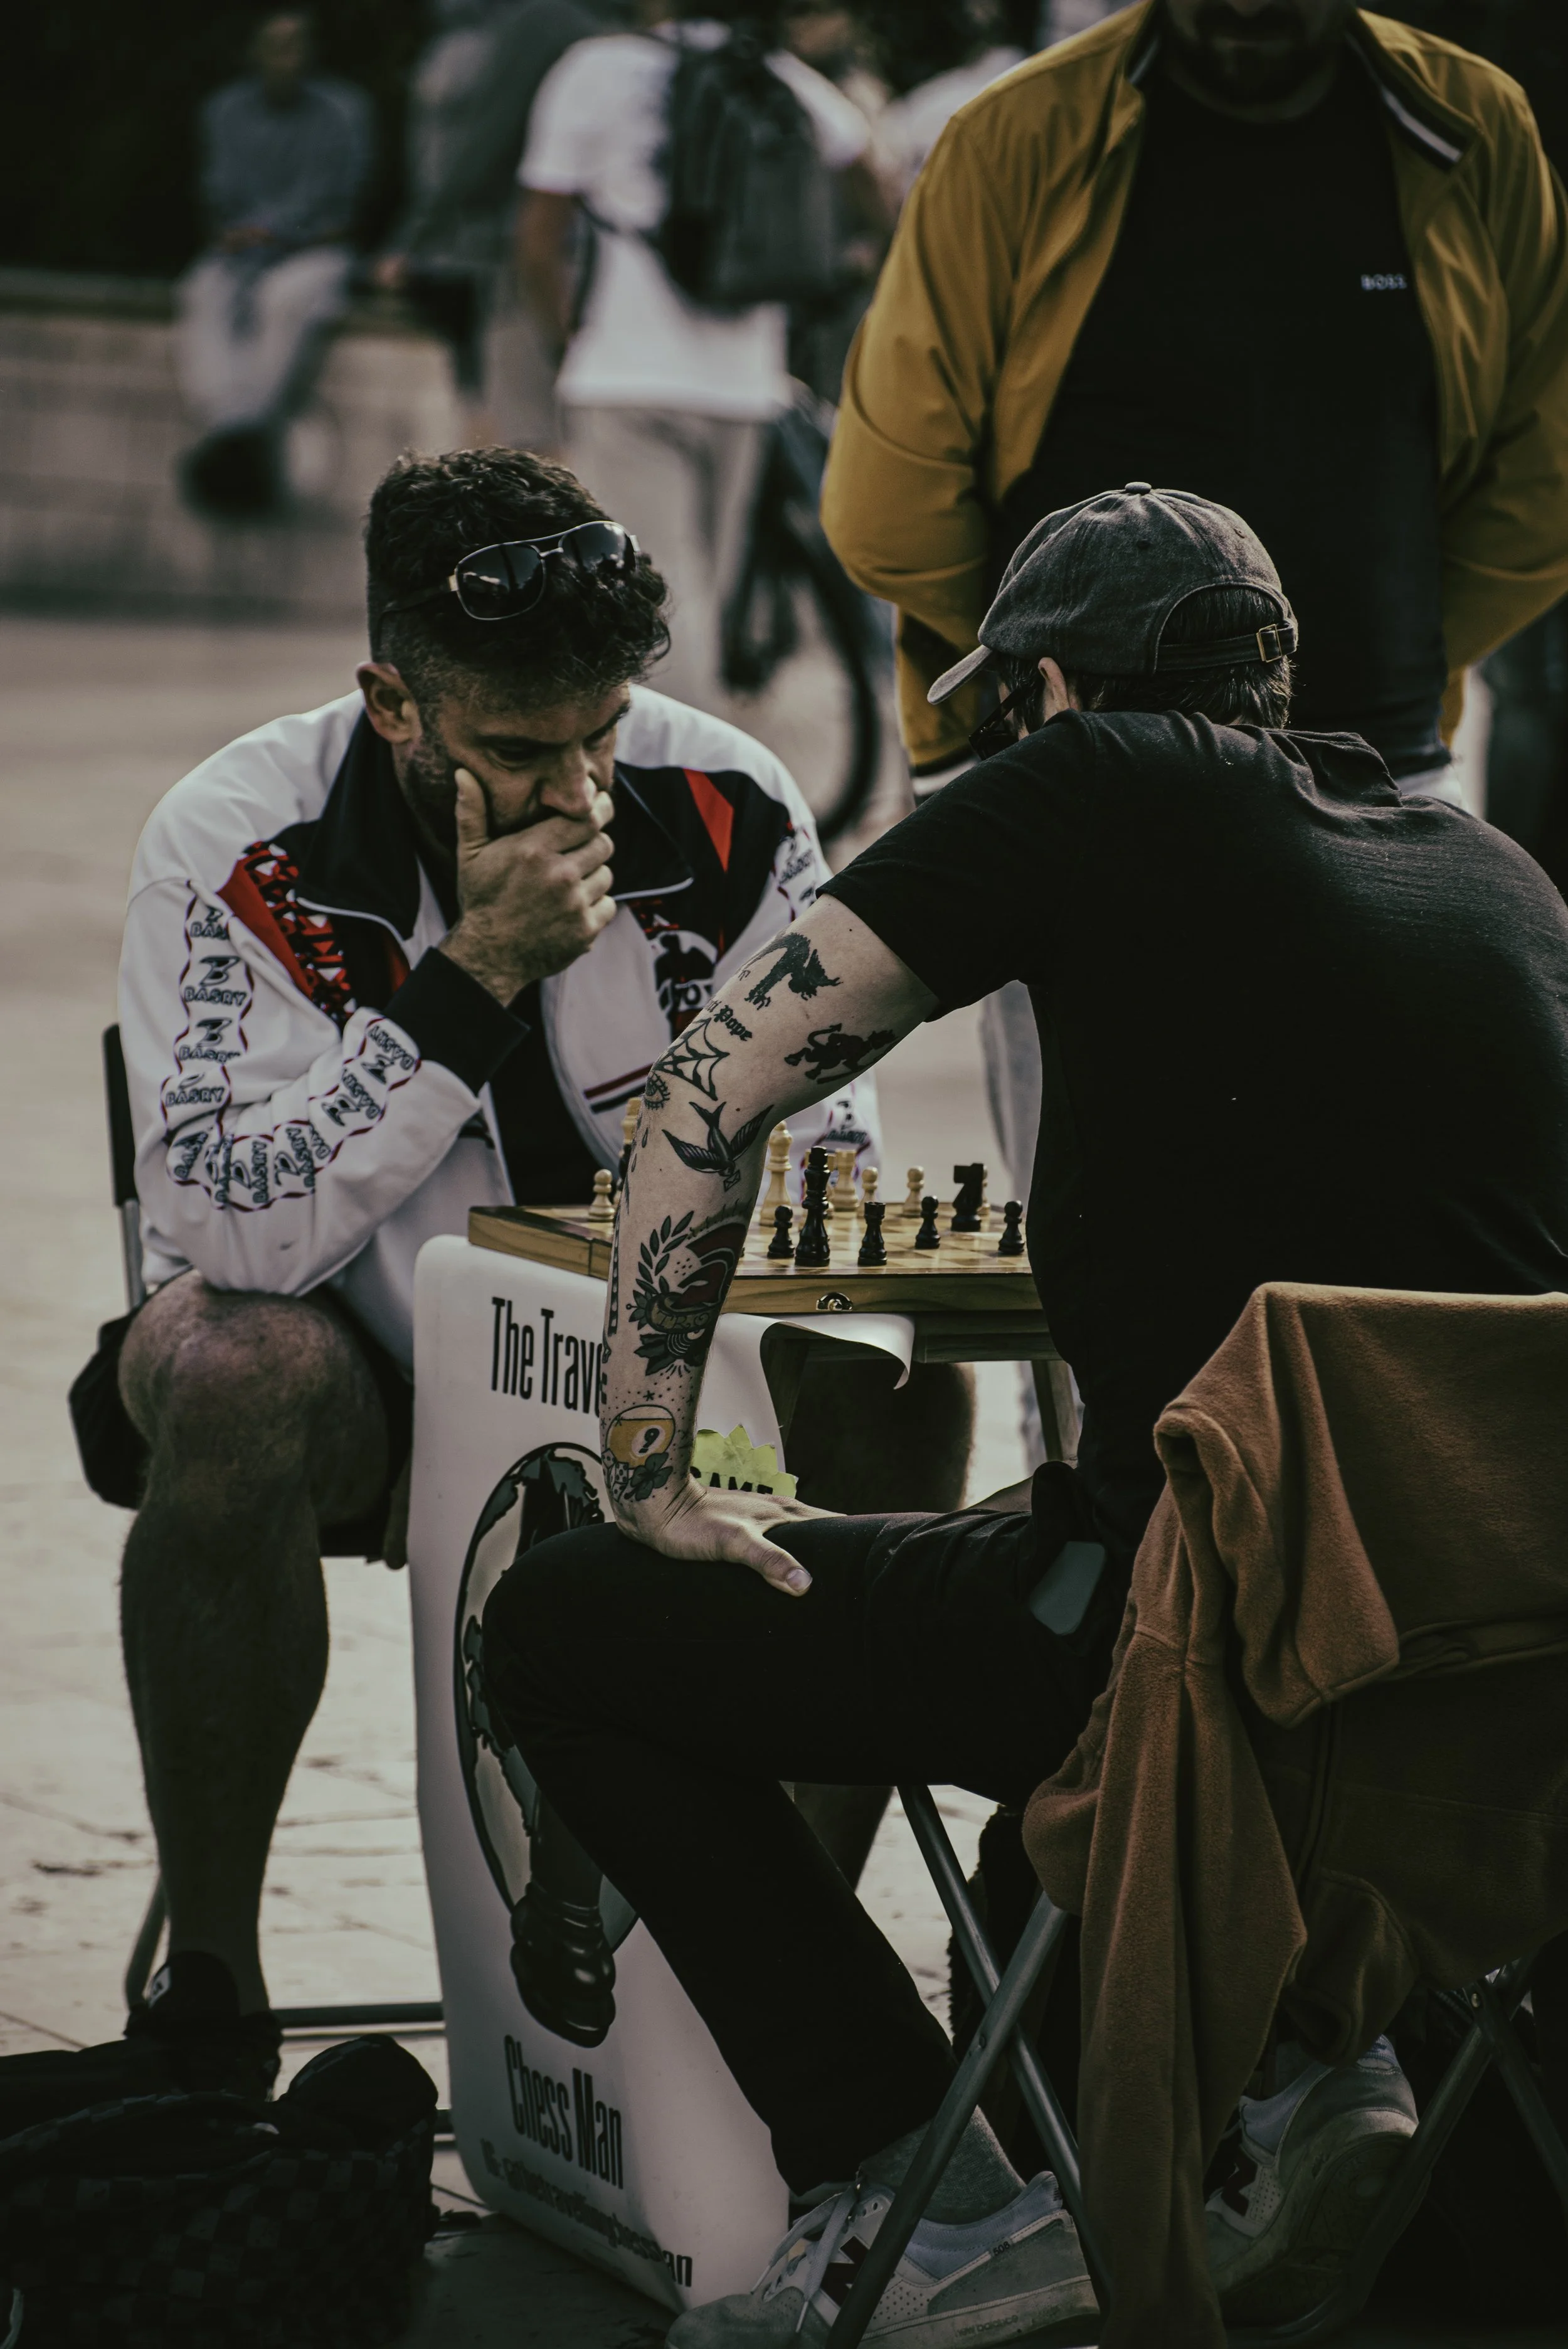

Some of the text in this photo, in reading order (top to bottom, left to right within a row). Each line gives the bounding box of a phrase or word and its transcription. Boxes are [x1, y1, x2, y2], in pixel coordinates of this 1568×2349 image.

[492, 1296, 602, 1418] The Trav
[638, 1428, 660, 1453] 9
[505, 2034, 623, 2190] Chess Man
[993, 2241, 1010, 2256] 508
